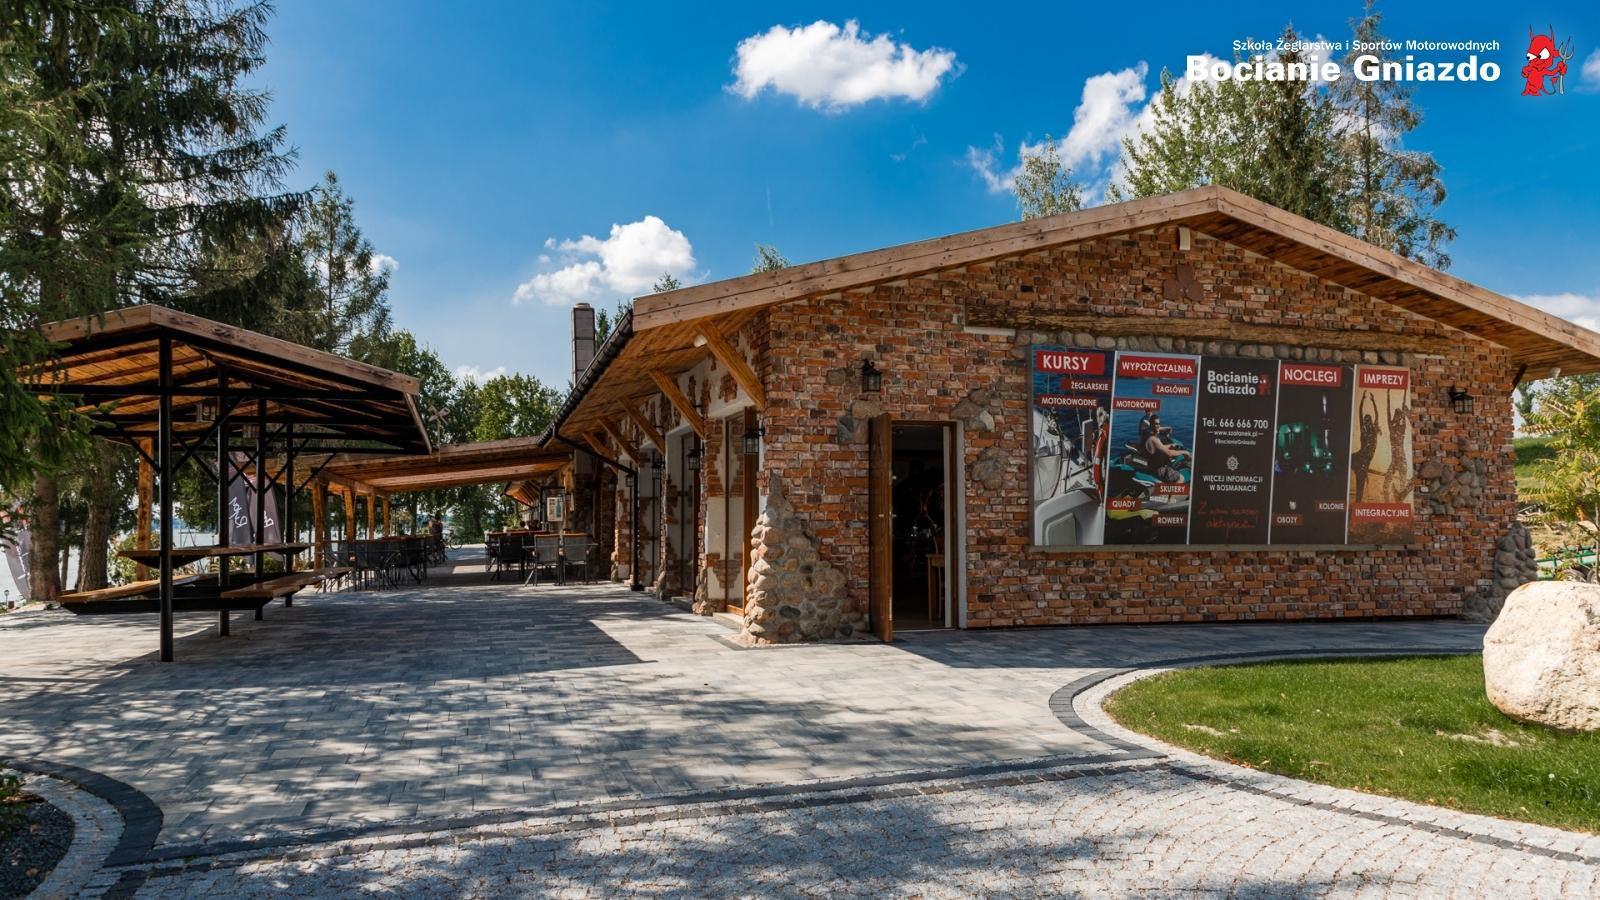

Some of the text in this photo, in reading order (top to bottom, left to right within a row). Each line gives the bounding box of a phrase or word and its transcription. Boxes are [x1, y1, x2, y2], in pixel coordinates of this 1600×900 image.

[1042, 355, 1089, 371] KURSY
[1121, 361, 1193, 374] WYPOŻYCZALNIA
[1207, 370, 1259, 384] Bocianie
[1284, 369, 1337, 383] NOCLEGI
[1363, 373, 1404, 385] IMPREZY
[1071, 381, 1109, 391] ŻEGLARSKIE
[1207, 382, 1256, 395] Gniazdo
[1041, 397, 1097, 407] MOTOROWODNE
[1116, 400, 1157, 409] MOTORÓWKI
[1202, 417, 1268, 429] Tel. 666 666 700
[1203, 475, 1263, 483] WIĘCEJ INFORMACJI
[1160, 485, 1186, 493] SKUTERY
[1217, 484, 1257, 492] BOSMANACIE
[1112, 500, 1136, 508] QUADY
[1319, 502, 1345, 510] KOLONIE
[1355, 508, 1410, 518] INTEGRACYJNE
[1276, 516, 1298, 524] OBOZY
